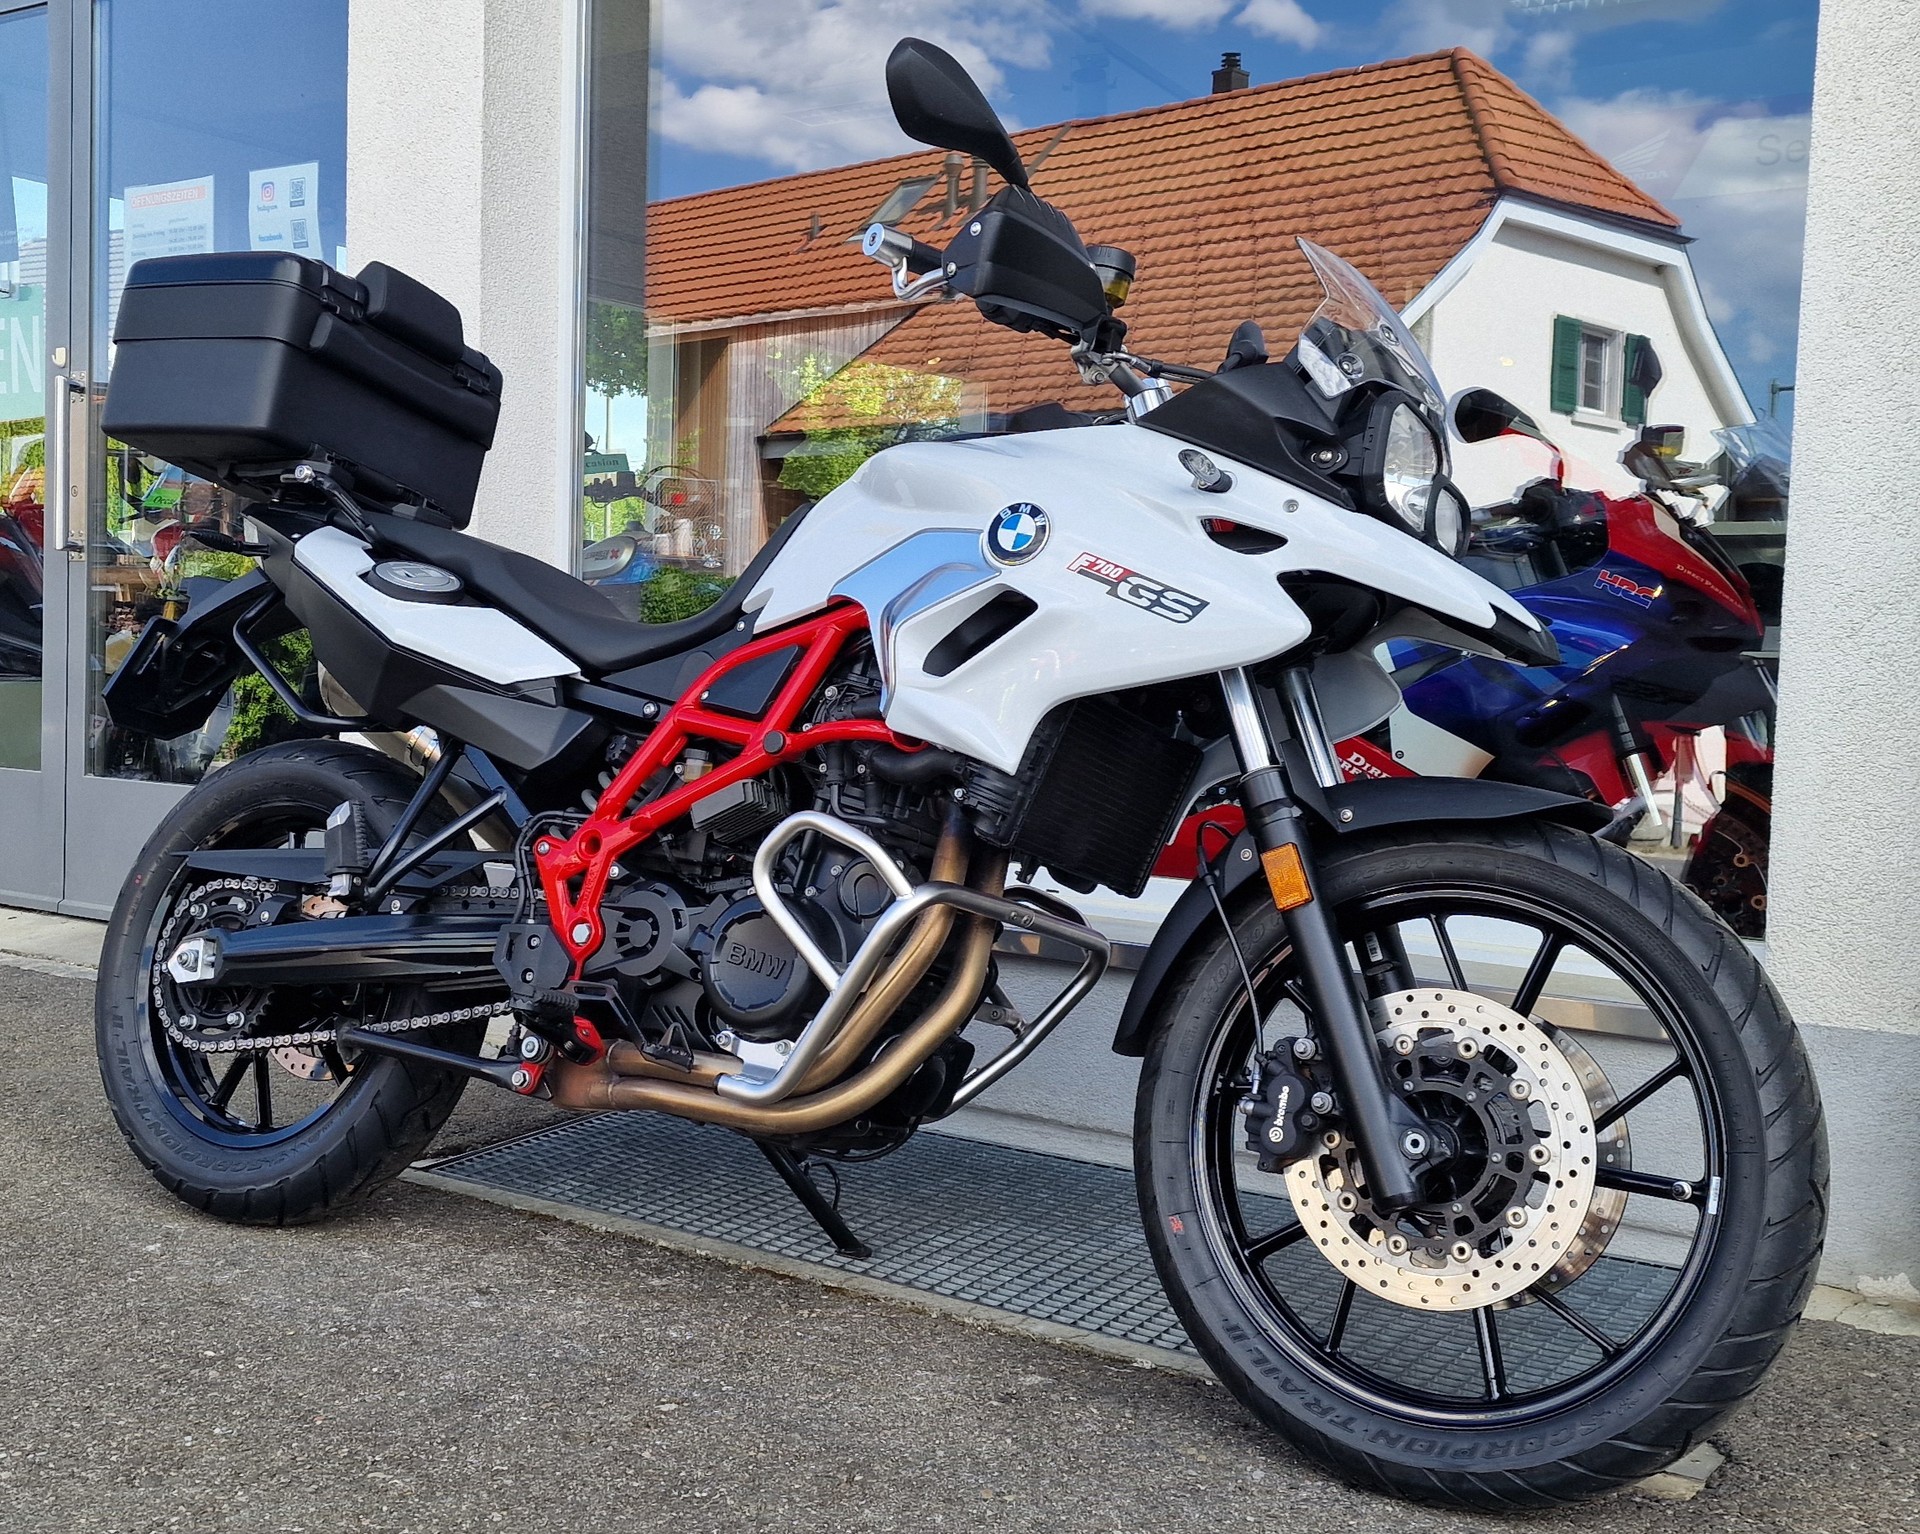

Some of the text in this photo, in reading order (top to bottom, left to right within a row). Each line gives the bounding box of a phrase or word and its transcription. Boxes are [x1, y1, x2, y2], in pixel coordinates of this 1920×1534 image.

[1000, 503, 1046, 527] BMW
[1117, 576, 1202, 622] GS
[1593, 569, 1662, 609] HRC
[727, 942, 787, 980] BMW
[1273, 1085, 1290, 1127] brembo
[1251, 1346, 1360, 1435] TRAIL
[1368, 1413, 1603, 1460] SCORPION
